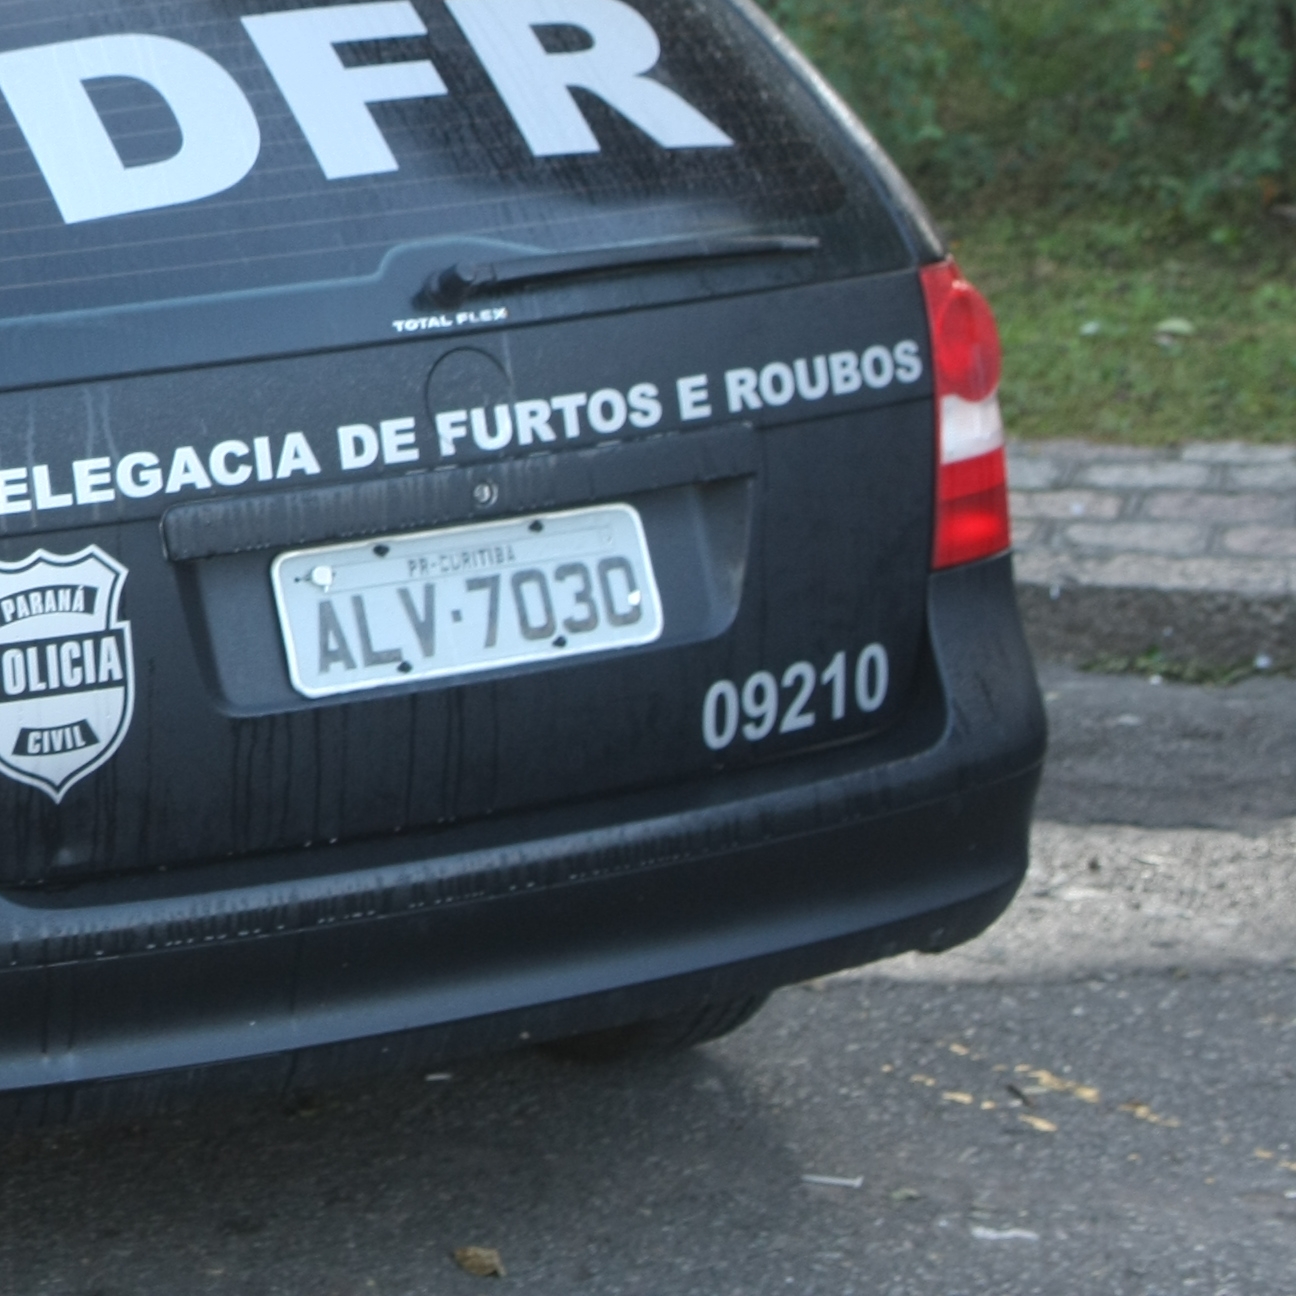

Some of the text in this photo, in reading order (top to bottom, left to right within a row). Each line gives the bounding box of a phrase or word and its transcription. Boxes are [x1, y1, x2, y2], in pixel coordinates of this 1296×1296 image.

[392, 307, 508, 332] TOTAL FLEX
[337, 417, 420, 471] DE
[435, 383, 663, 458] FURTOS
[676, 374, 712, 422] E
[723, 339, 923, 413] ROUBOS
[1, 585, 85, 623] PARANÁ
[702, 641, 889, 751] 09210
[26, 725, 86, 754] CIVIL
